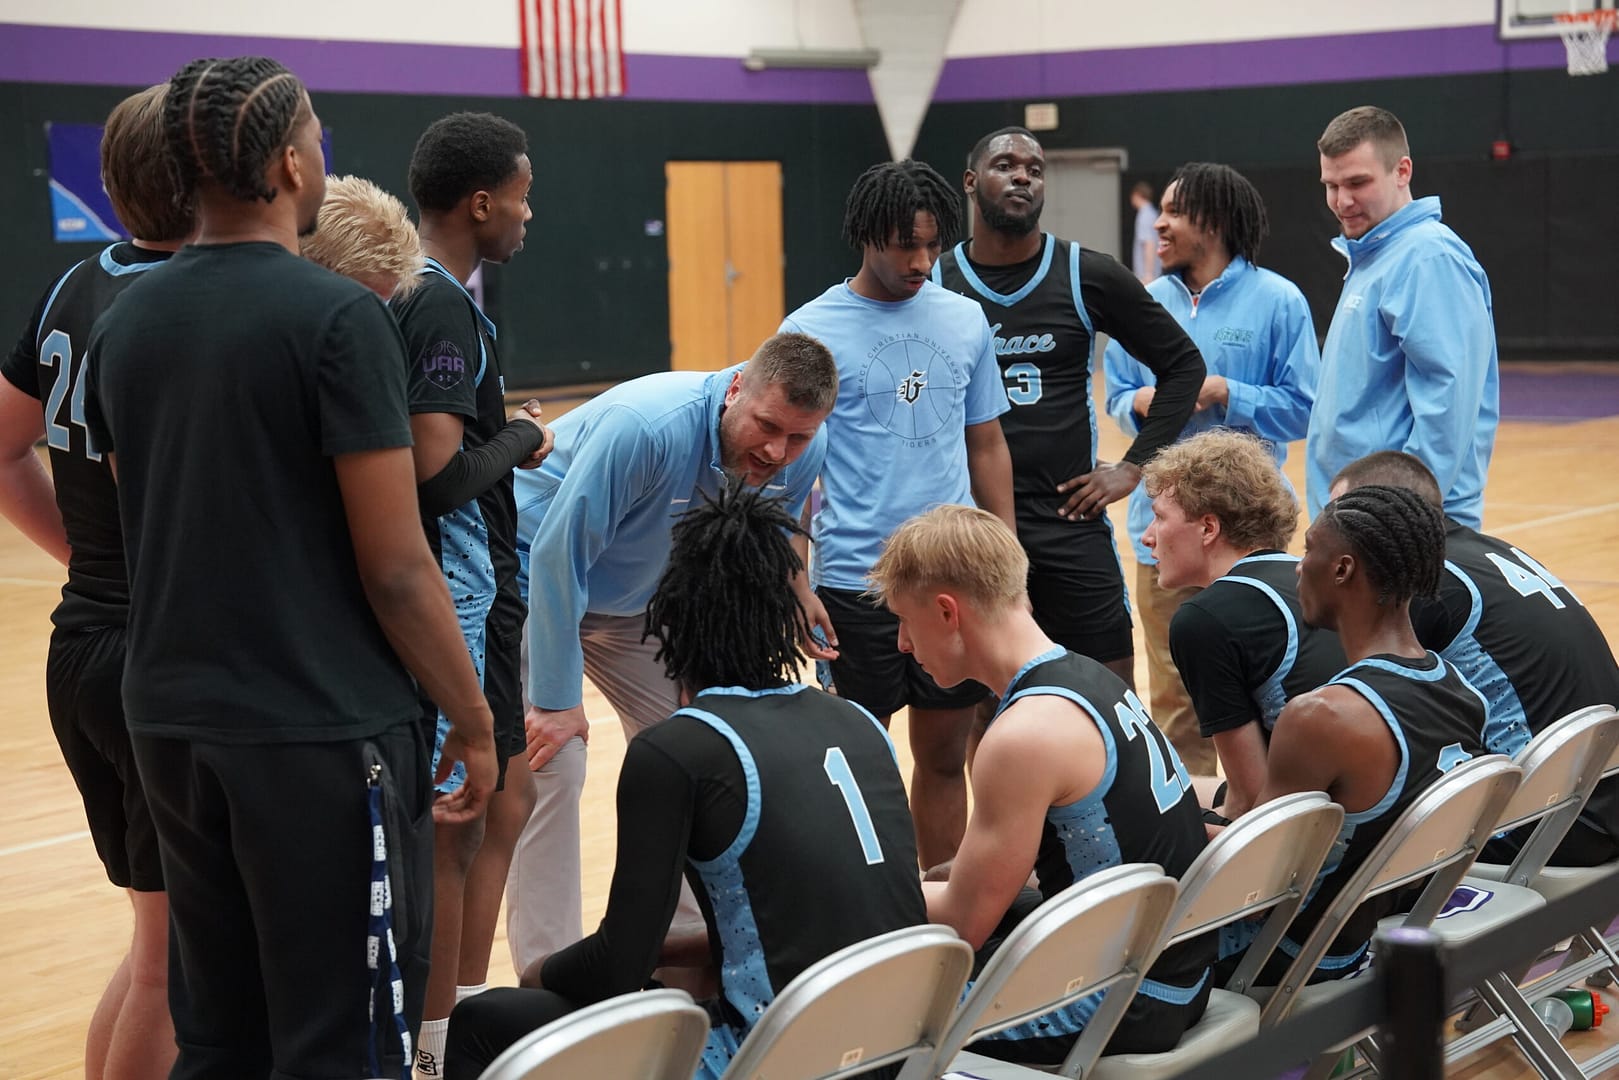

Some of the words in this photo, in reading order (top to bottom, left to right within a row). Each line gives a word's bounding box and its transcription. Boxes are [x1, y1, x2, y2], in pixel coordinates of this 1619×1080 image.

[867, 332, 920, 358] CHRISTIAN
[991, 322, 1057, 355] race
[902, 437, 937, 448] TIGERS
[1484, 546, 1584, 609] 44
[823, 746, 885, 865] 1
